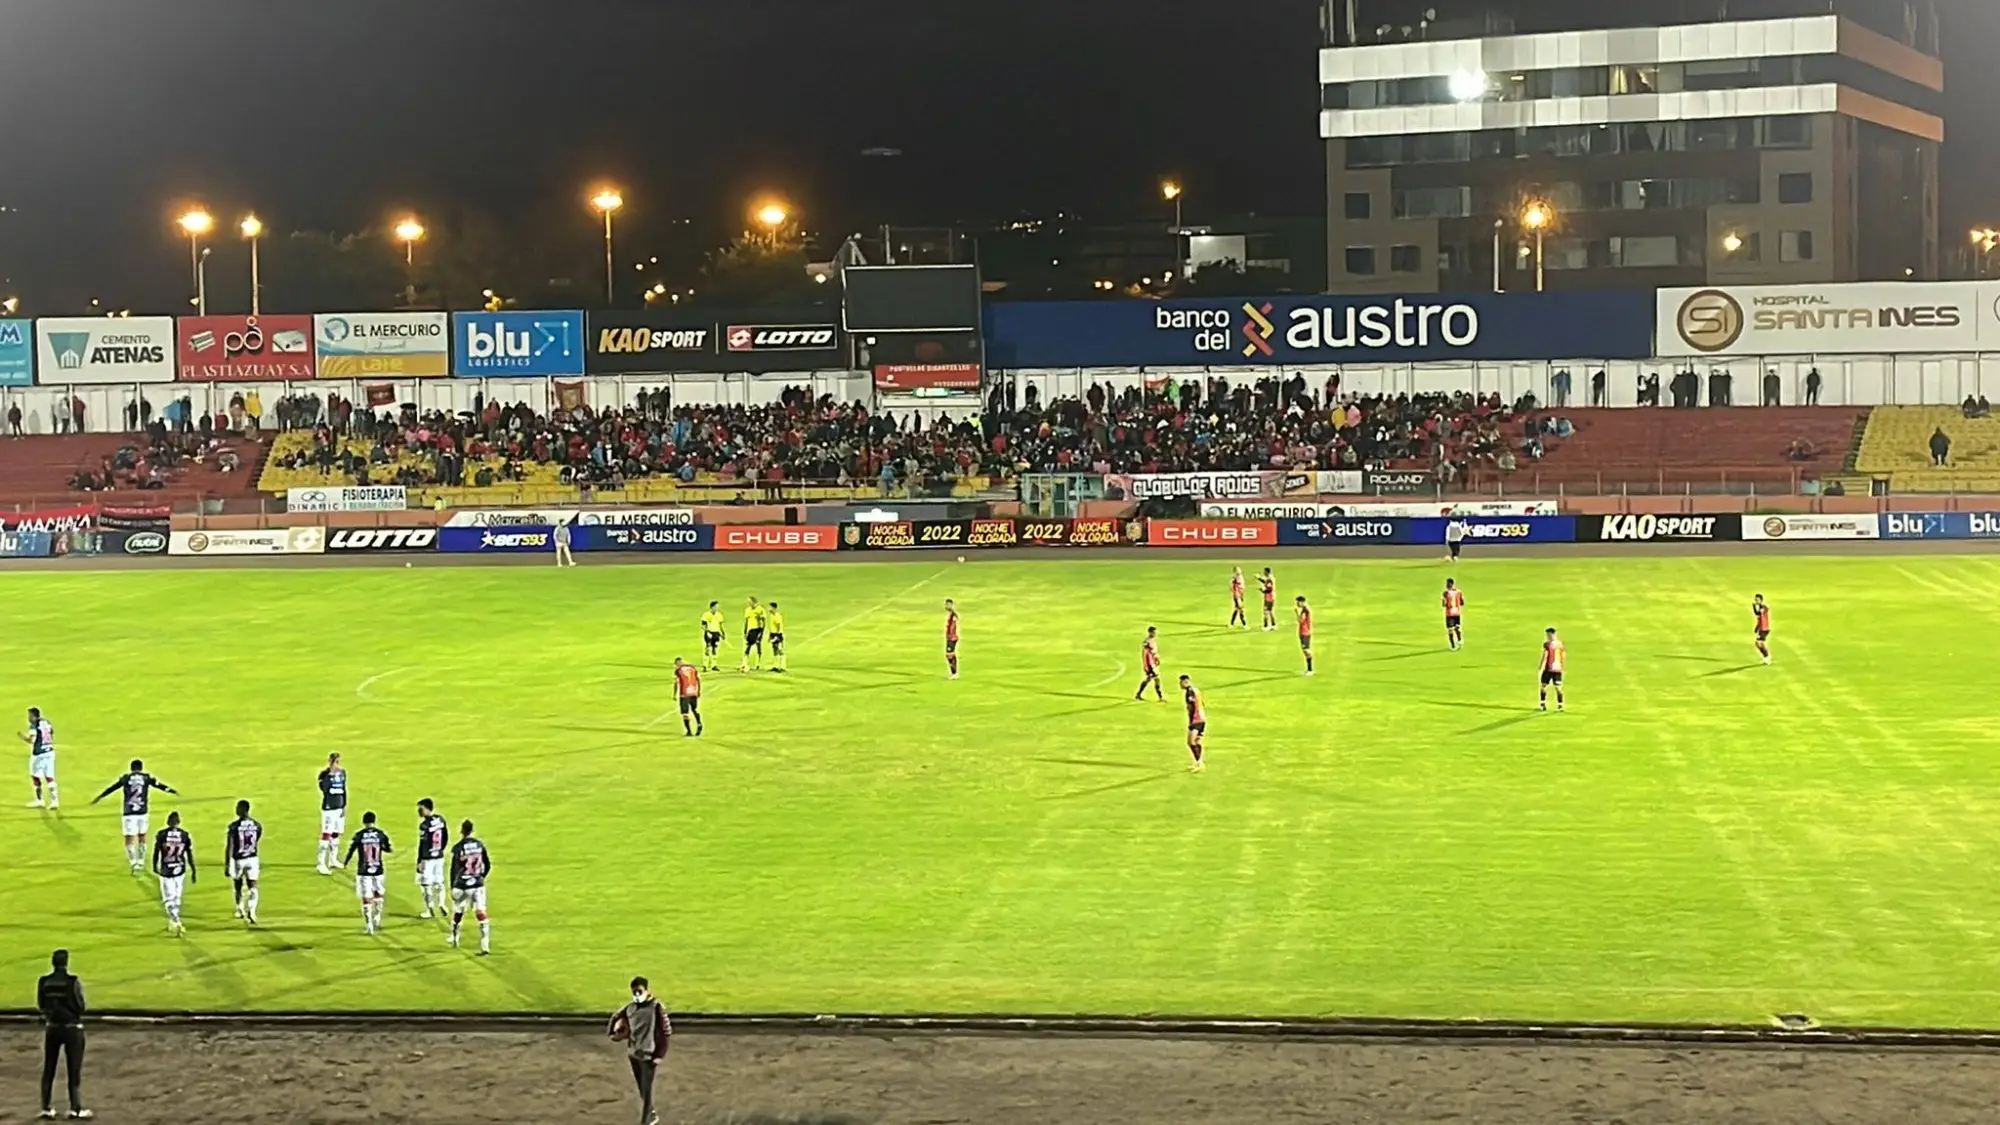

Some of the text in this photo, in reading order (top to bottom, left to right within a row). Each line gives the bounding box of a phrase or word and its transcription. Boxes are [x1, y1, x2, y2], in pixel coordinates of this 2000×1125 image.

[1753, 296, 1829, 305] HOSPITAL
[1156, 306, 1230, 328] banco
[1286, 298, 1478, 348] austro
[1752, 306, 1960, 330] SANTA INES
[353, 323, 441, 337] EL MERCURIO
[101, 335, 150, 344] CEMENTO
[467, 322, 530, 357] blu
[599, 328, 706, 353] KAO SPORT
[755, 330, 833, 345] LOTTO
[1194, 328, 1230, 350] del
[90, 347, 164, 364] ATENAS
[468, 358, 530, 367] LOGISTICS
[182, 365, 283, 378] PLASTIAZUAY
[1369, 474, 1424, 484] ROLAND
[1133, 477, 1261, 497] GLOBULOS ROJOS
[342, 488, 404, 500] FISIOTERAPIA
[288, 503, 338, 511] DINAMIC
[1244, 506, 1316, 518] MERCURIO
[16, 513, 91, 533] MACHALA
[620, 512, 691, 525] MERCURIO
[1888, 514, 1924, 533] blu
[606, 529, 629, 537] banco
[874, 525, 906, 536] NOCHE
[921, 526, 962, 541] 2022
[975, 523, 1008, 533] NOCHE
[1022, 524, 1064, 539] 2022
[1077, 522, 1112, 533] NOCHE
[1163, 527, 1258, 539] CHUBB
[1296, 523, 1319, 531] banco
[1335, 521, 1393, 536] austro
[1471, 524, 1530, 537] BET593
[1601, 515, 1716, 540] KAO SPORT
[330, 530, 437, 548] LOTTO
[493, 534, 548, 546] BET593
[642, 528, 697, 543] austro
[729, 532, 820, 544] CHUBB
[866, 536, 915, 546] COLORADA
[967, 533, 1017, 544] COLORADA
[1069, 532, 1119, 543] COLORADA
